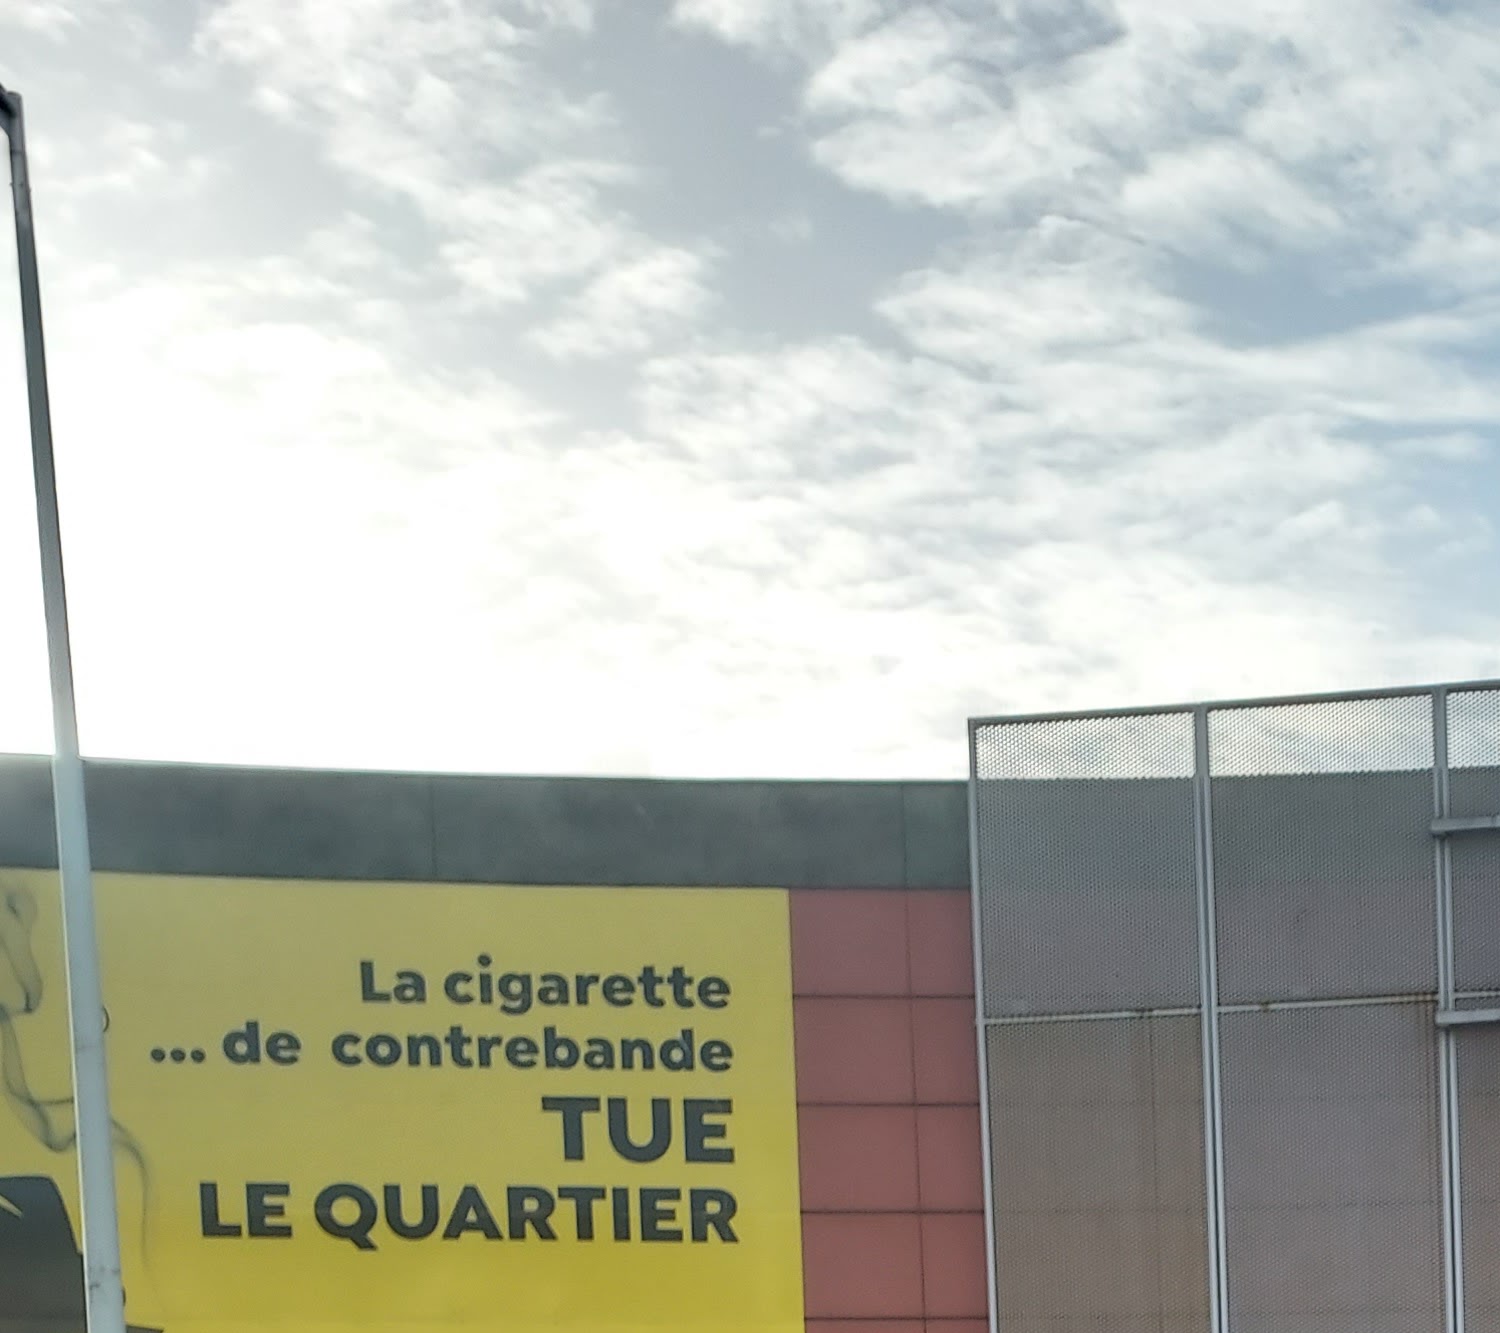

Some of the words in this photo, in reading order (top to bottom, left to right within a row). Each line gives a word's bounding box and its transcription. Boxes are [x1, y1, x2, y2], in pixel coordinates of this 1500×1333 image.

[360, 961, 426, 1005] La
[443, 955, 732, 1015] cigarette
[222, 1021, 302, 1066] de
[331, 1024, 734, 1072] contrebande
[542, 1096, 736, 1163] TUE
[200, 1182, 292, 1237] LE
[315, 1184, 739, 1251] QUARTIER
